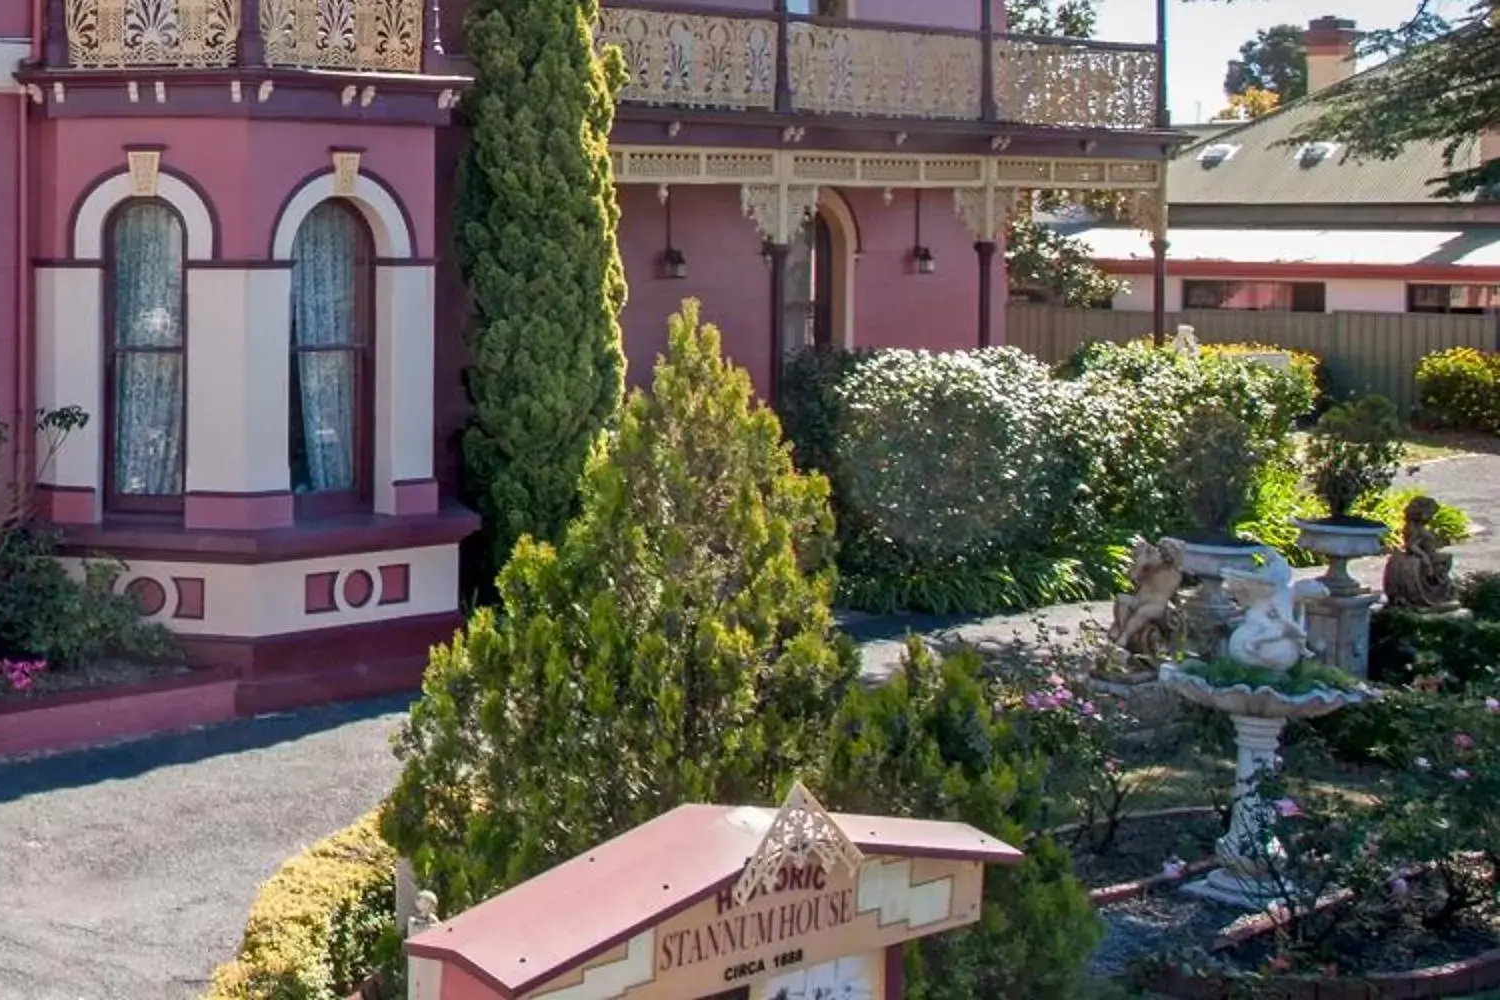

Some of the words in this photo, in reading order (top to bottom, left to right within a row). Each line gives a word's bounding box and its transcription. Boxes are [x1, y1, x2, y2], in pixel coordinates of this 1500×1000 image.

[714, 862, 827, 916] HORIC
[660, 908, 775, 972] STANNUM
[777, 888, 853, 941] HOUSE
[723, 957, 766, 982] CIRCA
